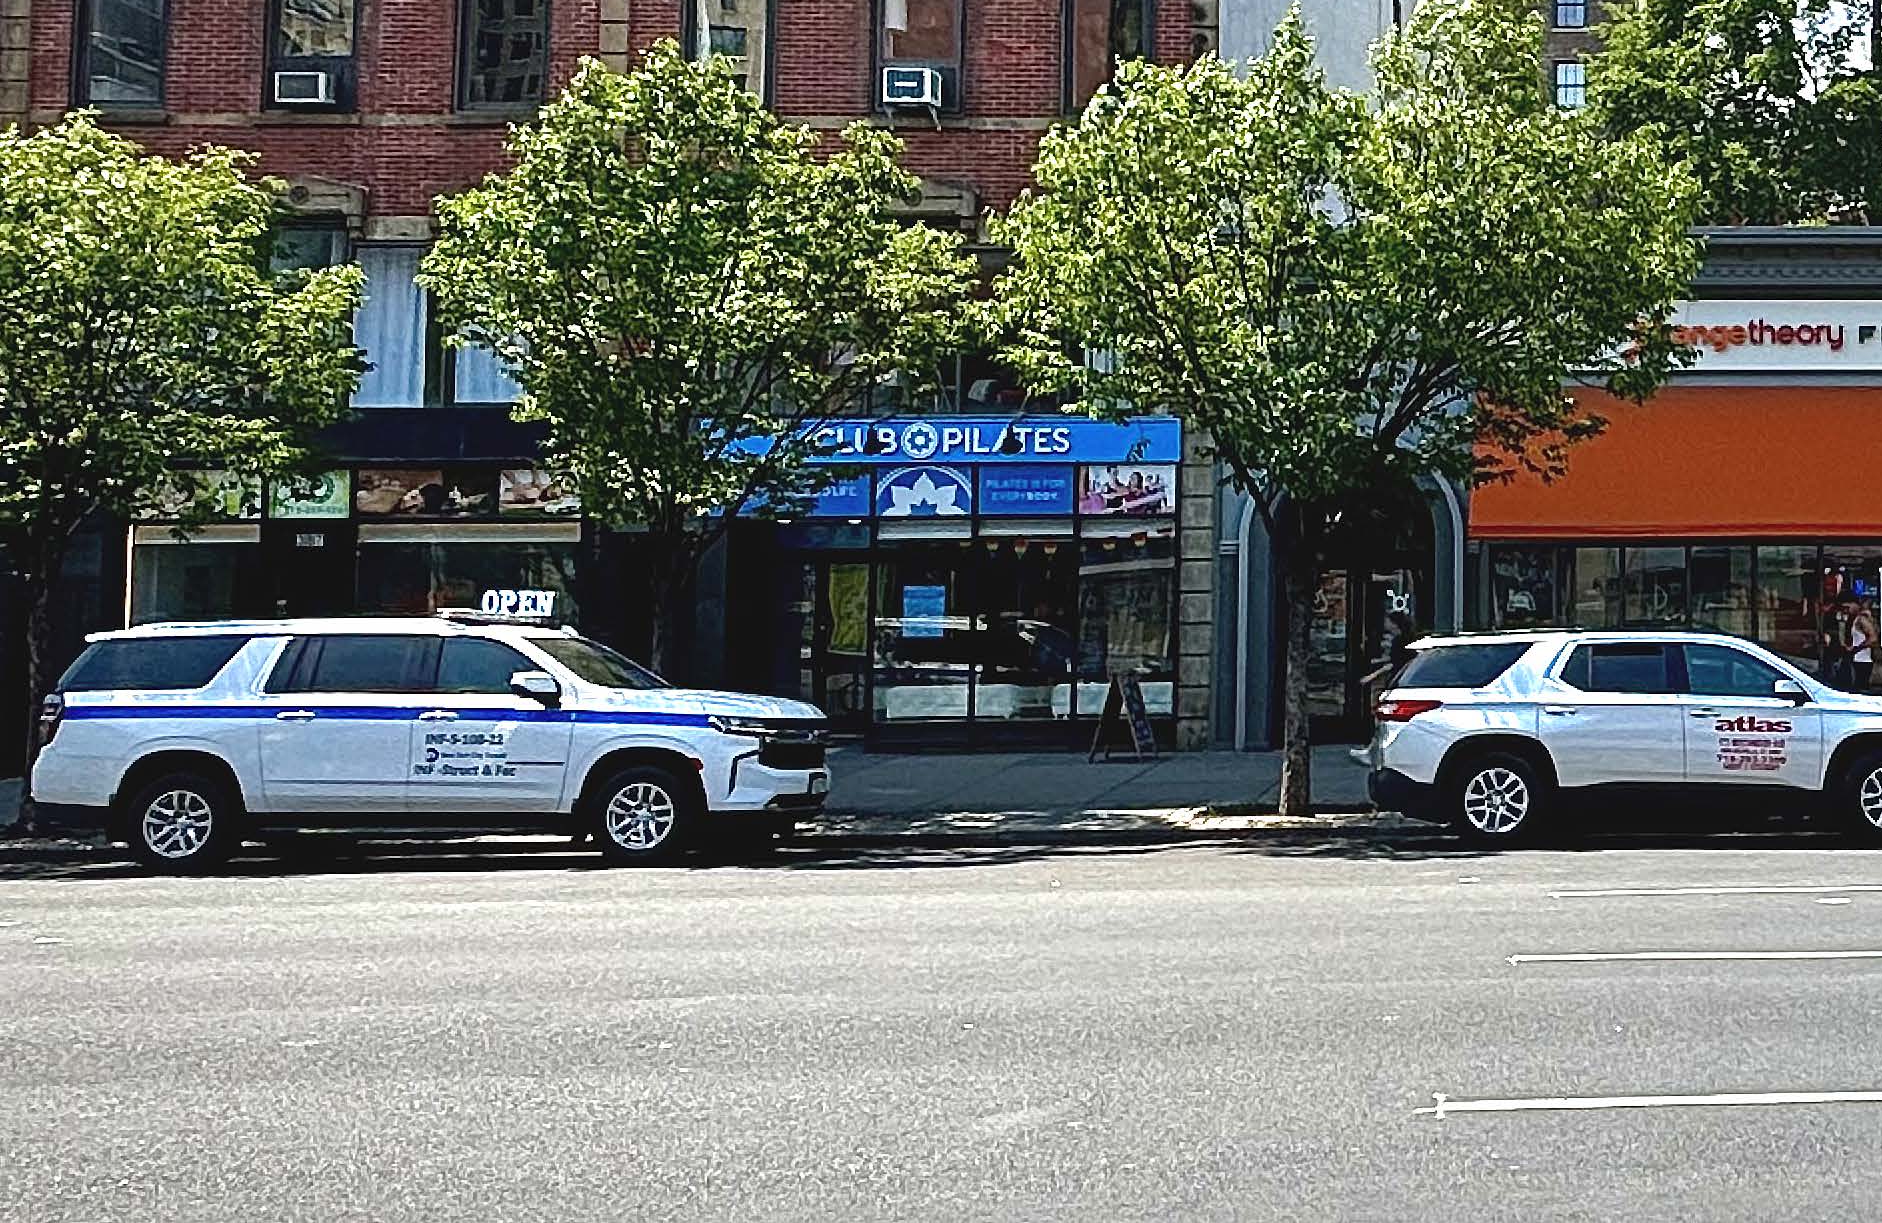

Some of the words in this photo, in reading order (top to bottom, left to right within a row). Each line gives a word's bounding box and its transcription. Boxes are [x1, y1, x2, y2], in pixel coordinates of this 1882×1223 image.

[1668, 319, 1846, 353] angetheory
[481, 589, 556, 616] OPEN
[1714, 715, 1793, 733] atlas
